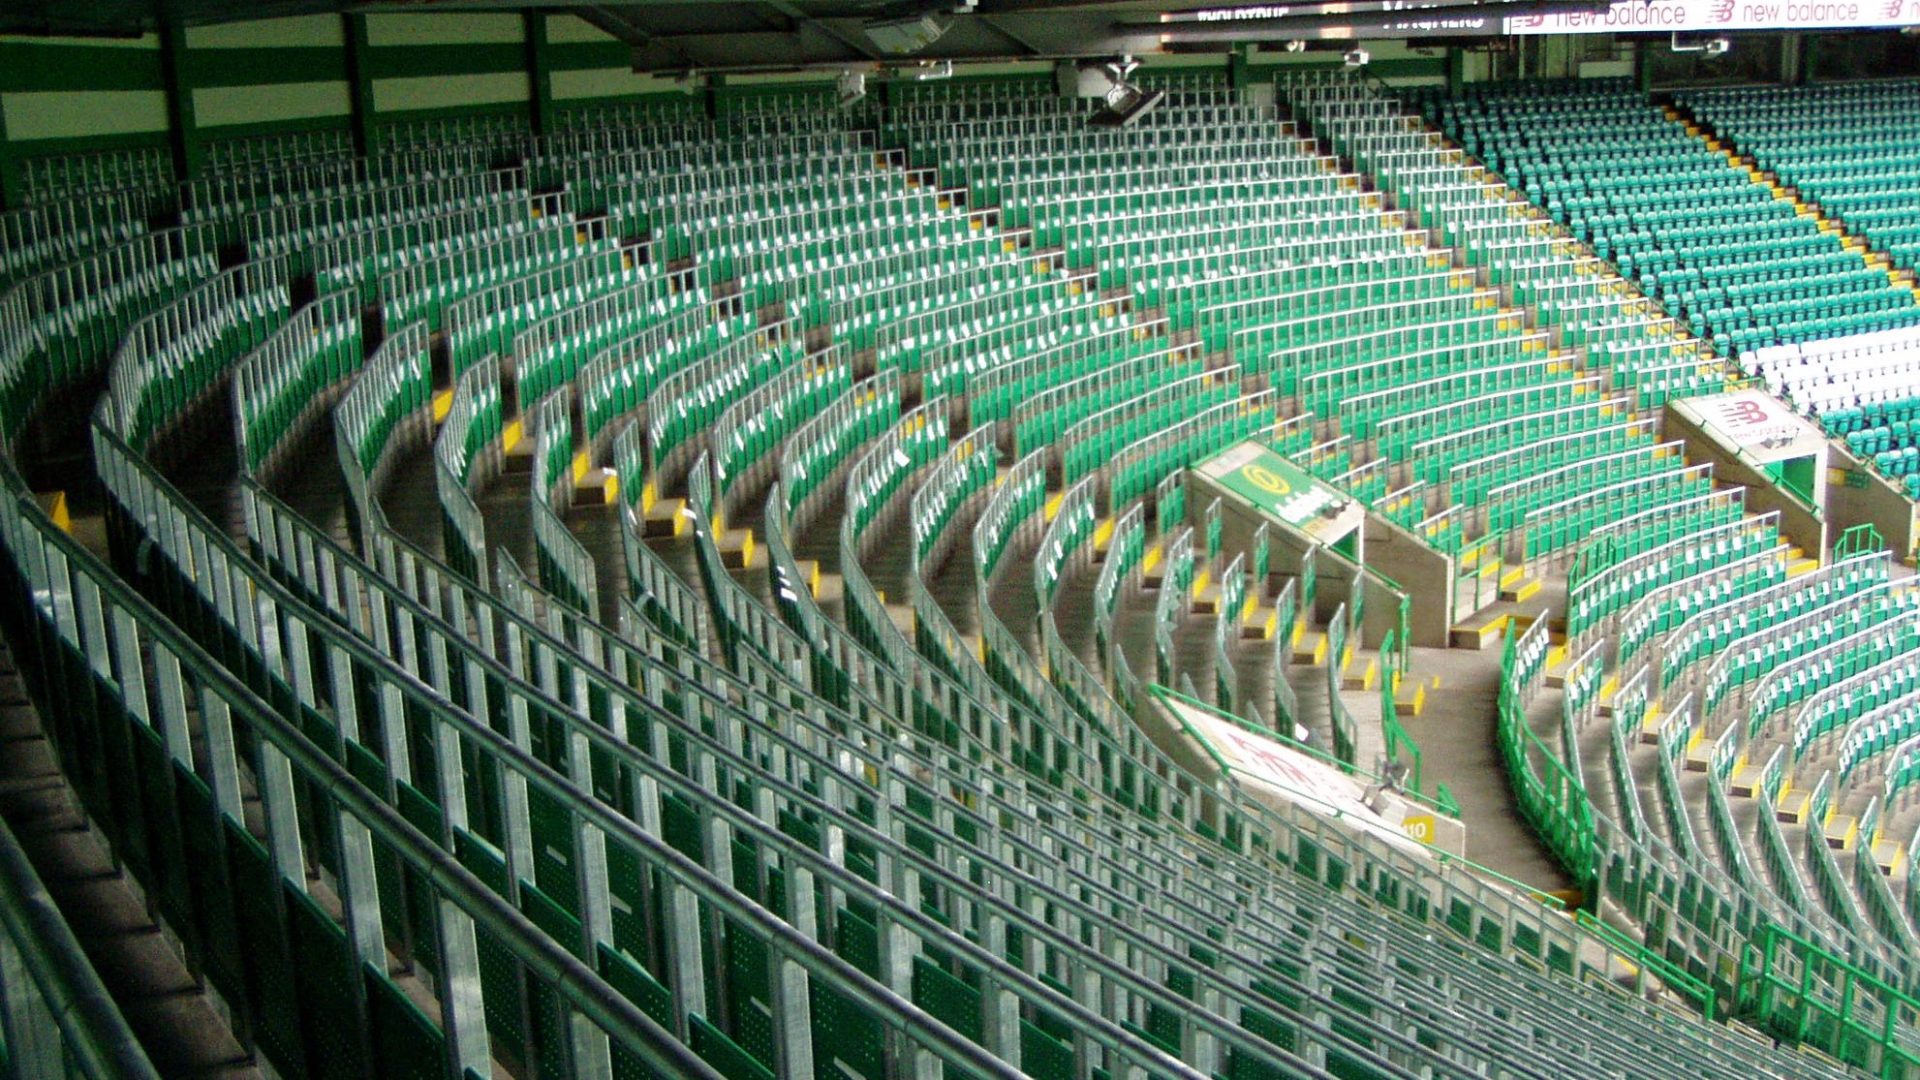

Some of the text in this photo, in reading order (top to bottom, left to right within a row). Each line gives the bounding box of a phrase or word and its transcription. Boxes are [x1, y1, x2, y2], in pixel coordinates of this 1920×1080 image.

[1556, 11, 1597, 27] new
[1604, 0, 1686, 26] balance
[1743, 0, 1859, 22] new balance
